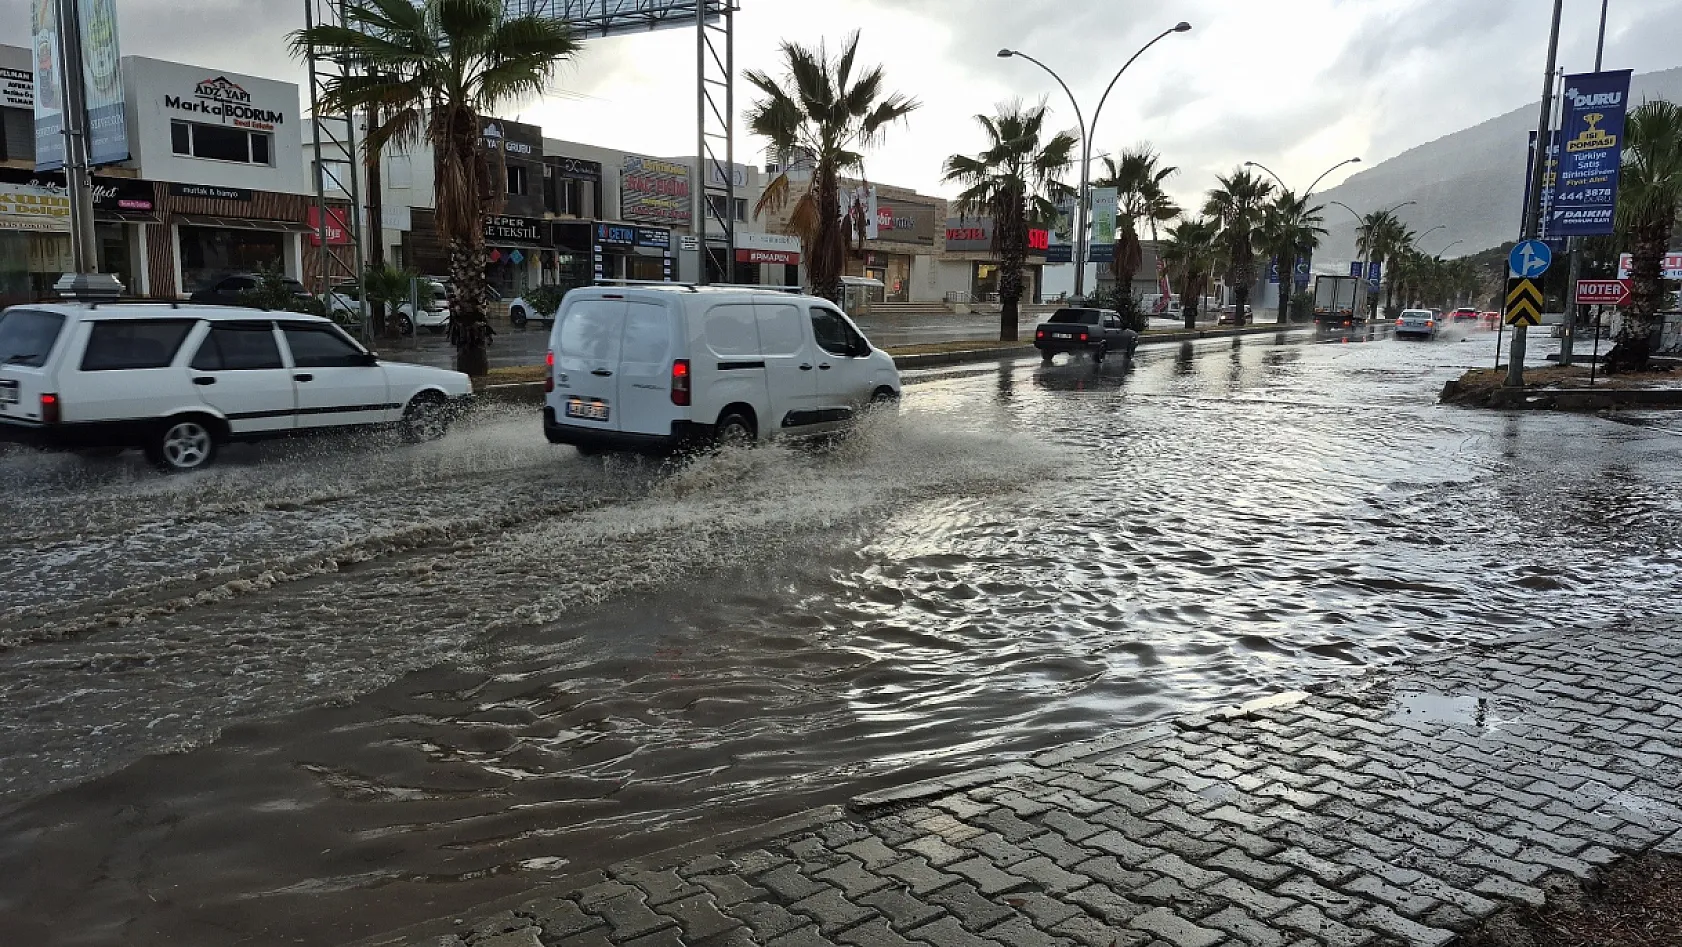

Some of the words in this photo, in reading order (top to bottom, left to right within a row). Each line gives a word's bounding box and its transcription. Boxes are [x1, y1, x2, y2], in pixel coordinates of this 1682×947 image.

[1574, 92, 1622, 107] DURU
[165, 94, 222, 116] Marka
[225, 104, 284, 124] BODRUM
[1570, 138, 1614, 149] POMPASI
[1573, 151, 1607, 161] Türkiye
[1558, 192, 1584, 201] 444
[1564, 210, 1613, 218] DAIKIN
[1579, 283, 1621, 295] NOTER
